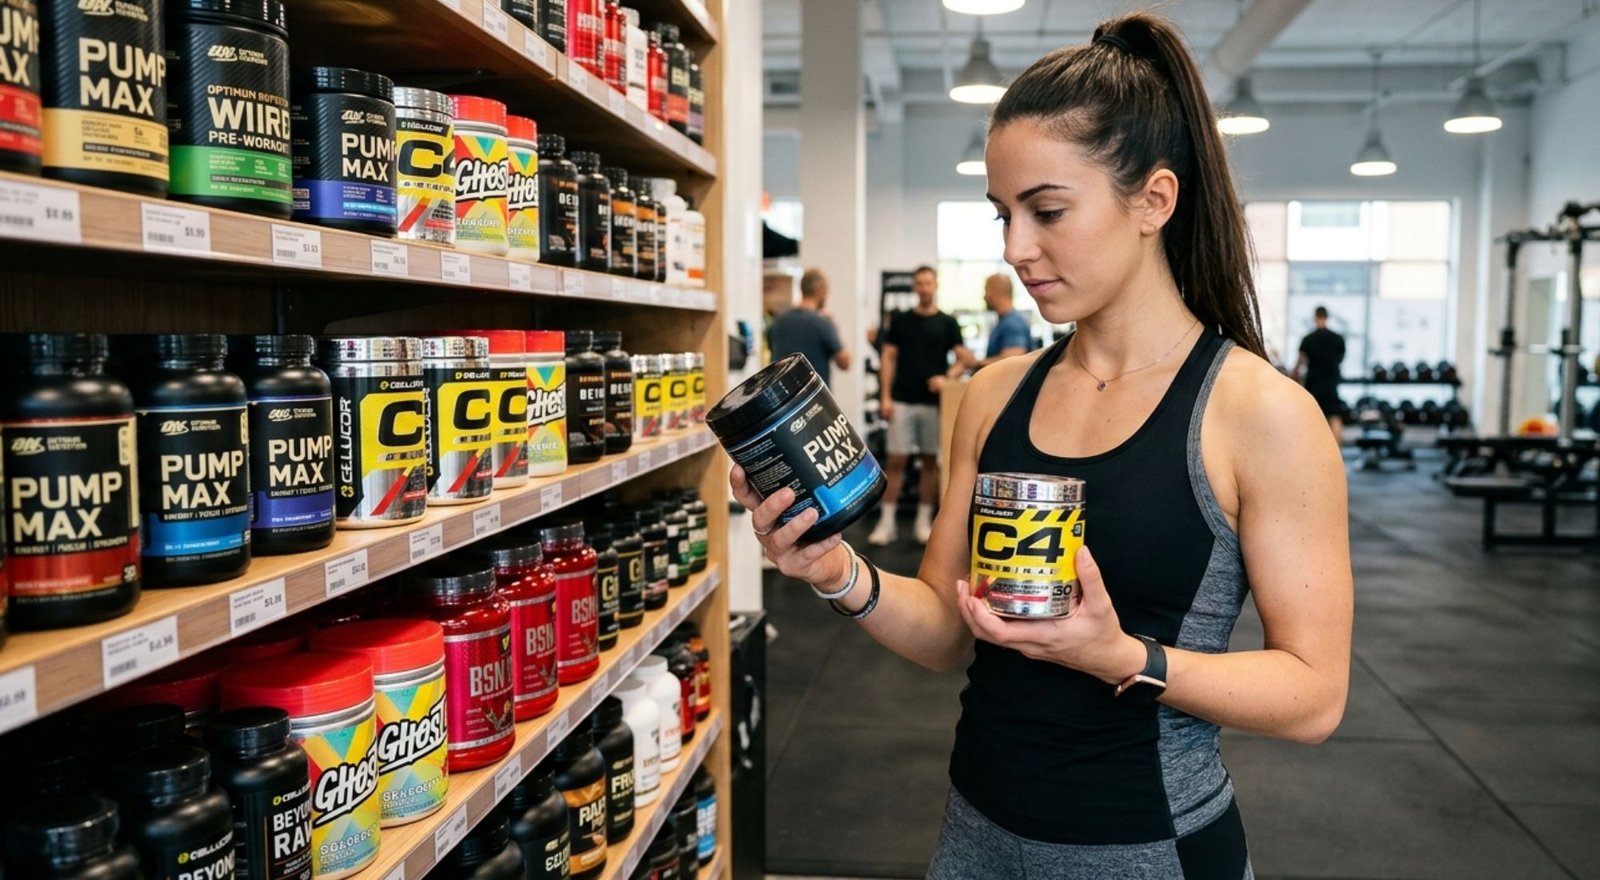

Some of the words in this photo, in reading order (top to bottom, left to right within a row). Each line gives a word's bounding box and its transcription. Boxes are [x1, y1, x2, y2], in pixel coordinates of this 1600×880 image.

[78, 37, 166, 88] PUMP
[80, 78, 154, 117] MAX
[342, 157, 389, 183] MAX
[268, 436, 332, 463] PUMP
[803, 413, 850, 463] PUMP
[161, 450, 244, 482] PUMP
[269, 461, 325, 488] MAX
[816, 437, 859, 480] MAX
[12, 472, 122, 510] PUMP
[162, 480, 231, 510] MAX
[13, 507, 103, 543] MAX
[977, 522, 1065, 564] C4
[526, 622, 555, 656] BSN
[469, 661, 505, 697] BSN
